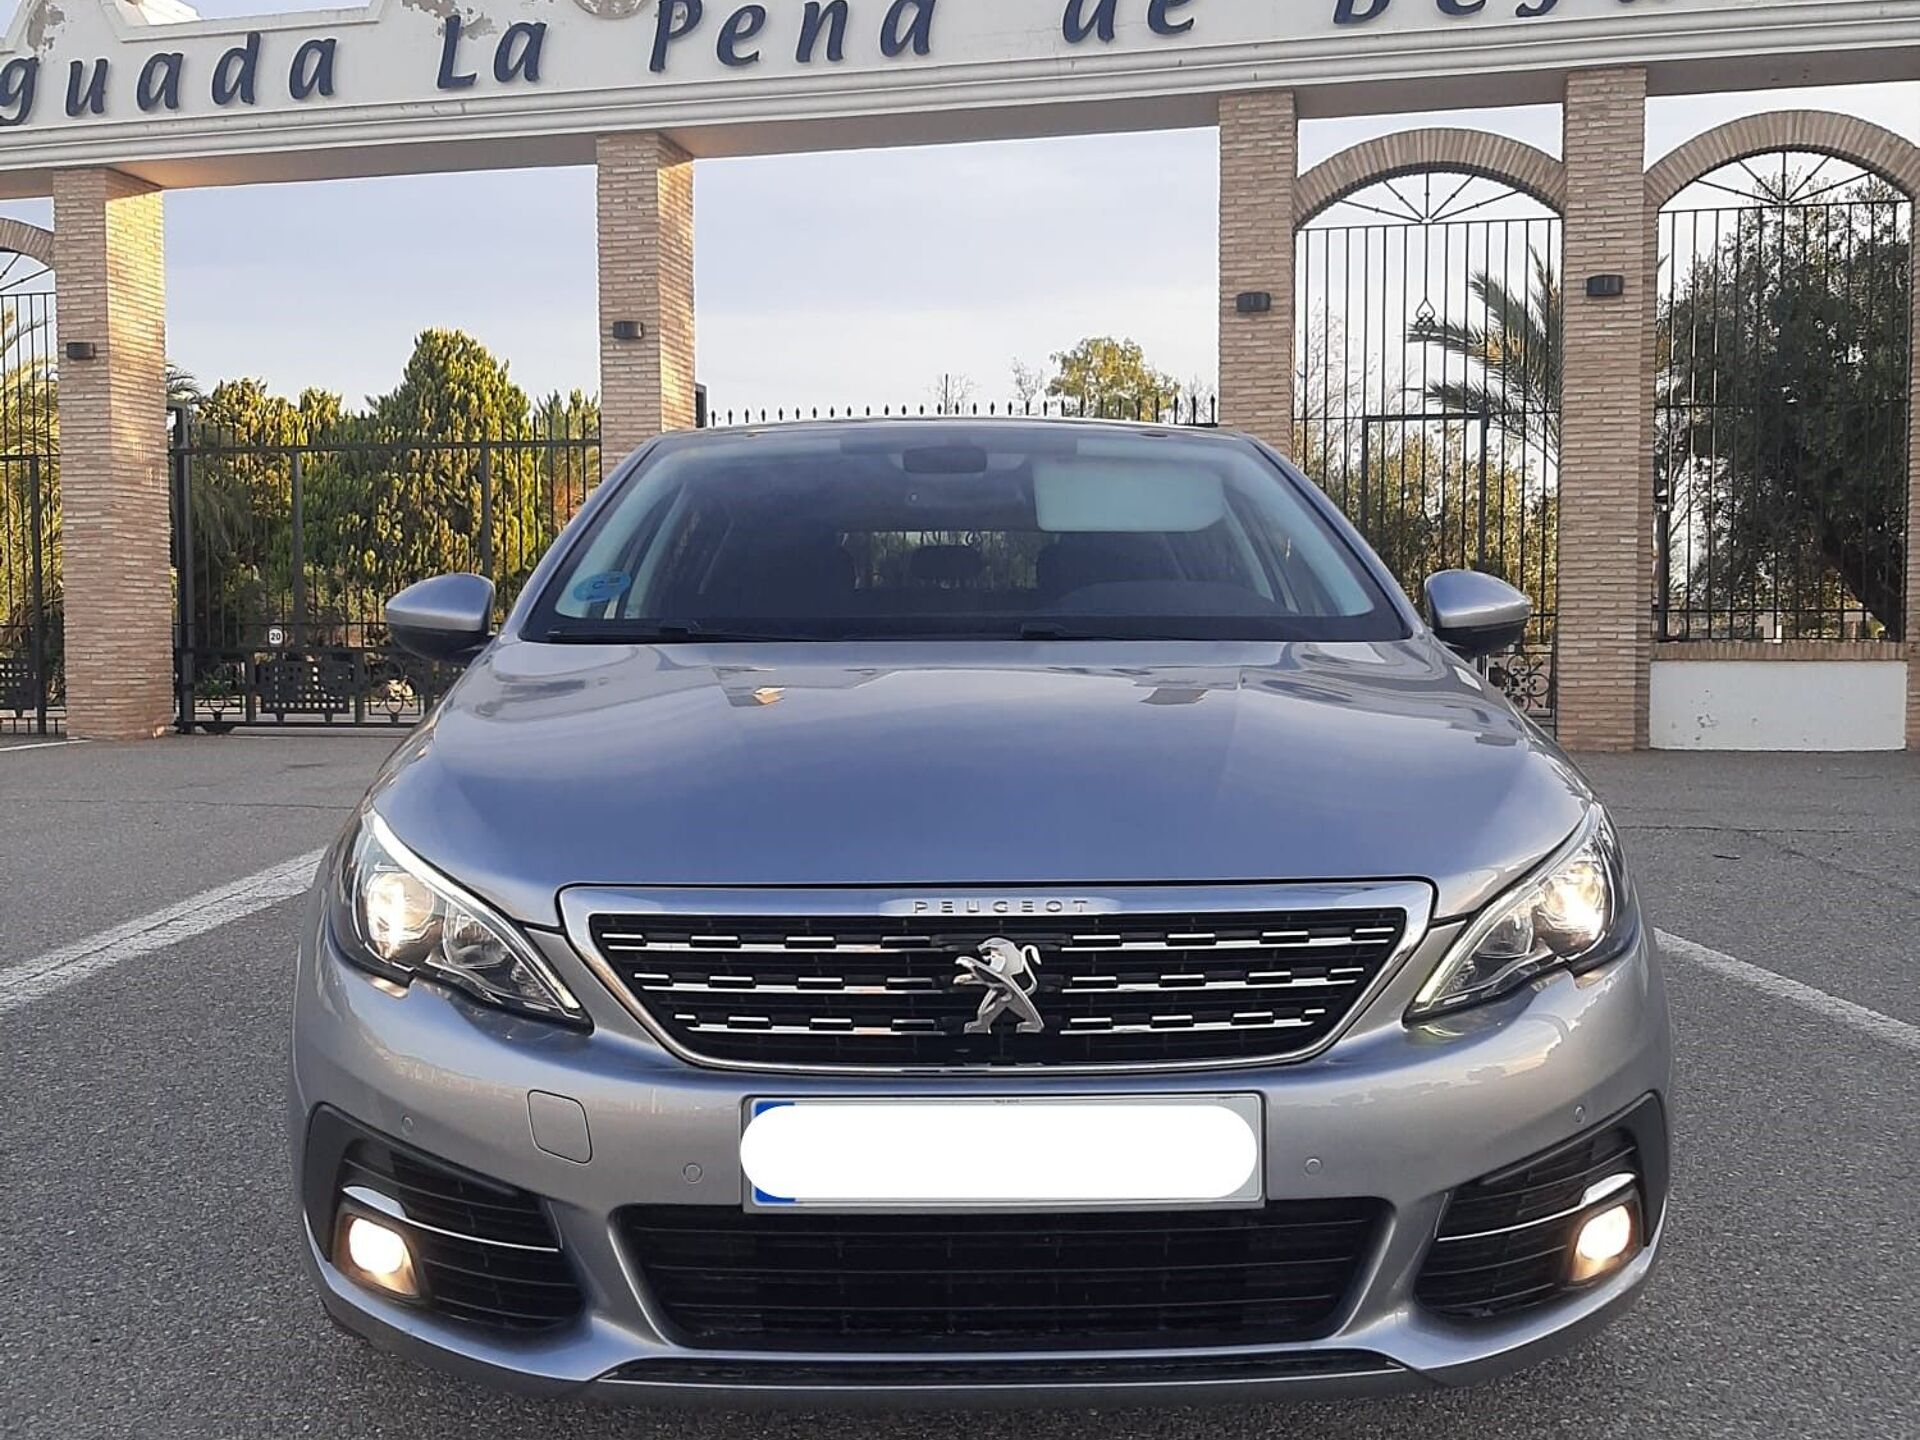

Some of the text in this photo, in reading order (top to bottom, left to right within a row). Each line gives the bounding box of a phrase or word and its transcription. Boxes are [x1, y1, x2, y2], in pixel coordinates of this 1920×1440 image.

[438, 15, 547, 89] La
[270, 632, 281, 641] 20
[914, 901, 1088, 914] PEUGEOT
